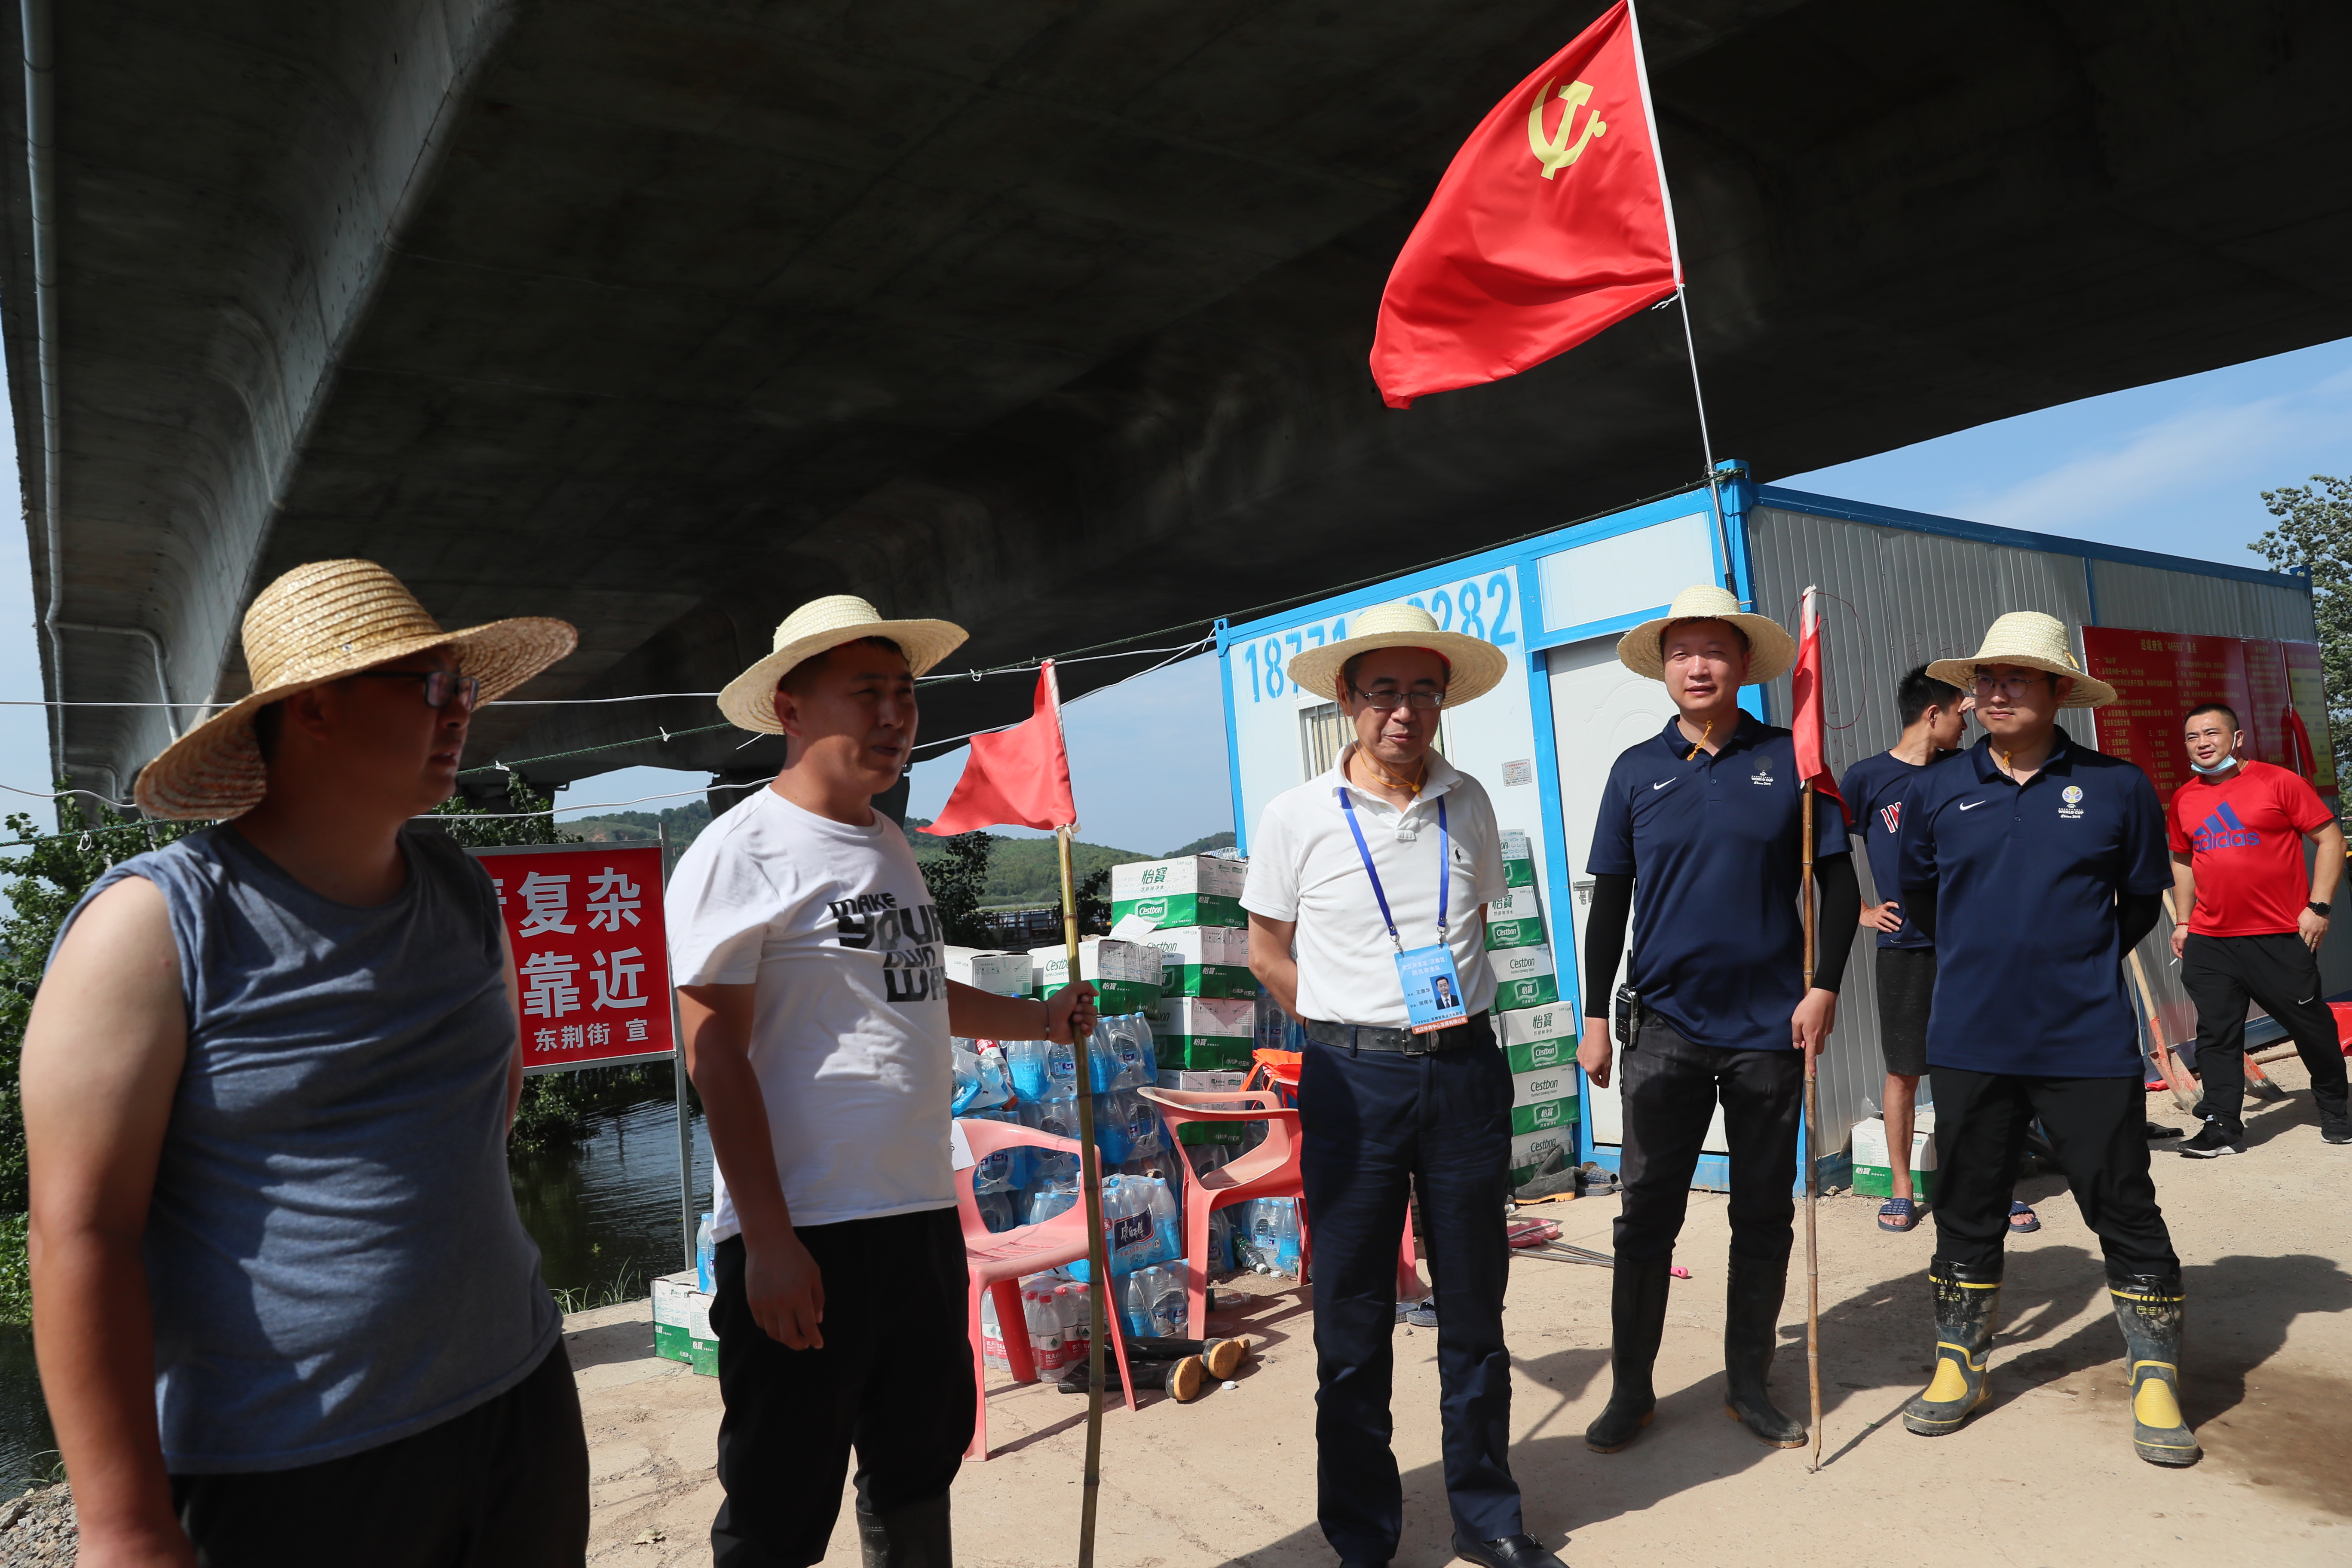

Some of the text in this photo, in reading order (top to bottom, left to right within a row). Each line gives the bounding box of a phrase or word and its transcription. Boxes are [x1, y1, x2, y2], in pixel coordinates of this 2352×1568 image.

[1245, 573, 1516, 703] 187282
[2141, 639, 2163, 651] 巡堤查险
[2193, 831, 2260, 853] adidas
[1141, 867, 1168, 885] 怡寶
[827, 892, 897, 918] MAKE
[1139, 906, 1163, 916] C'estbon
[1496, 928, 1516, 937] C'estbon
[883, 946, 936, 968] OWN
[1510, 957, 1535, 969] C'estbon
[1046, 958, 1069, 971] C'estb
[1412, 965, 1441, 976] 防汛突击队
[520, 946, 649, 1018] 靠近
[1415, 1017, 1467, 1033] 武汉体育中心发展有限公司
[1532, 1013, 1553, 1029] 怡寶
[534, 1018, 648, 1052] 东荆街 宣
[1193, 1038, 1207, 1046] 怡寶
[1535, 1047, 1555, 1057] C'estbon
[1530, 1079, 1558, 1092] C'estbon
[1530, 1138, 1556, 1152] C'estbon
